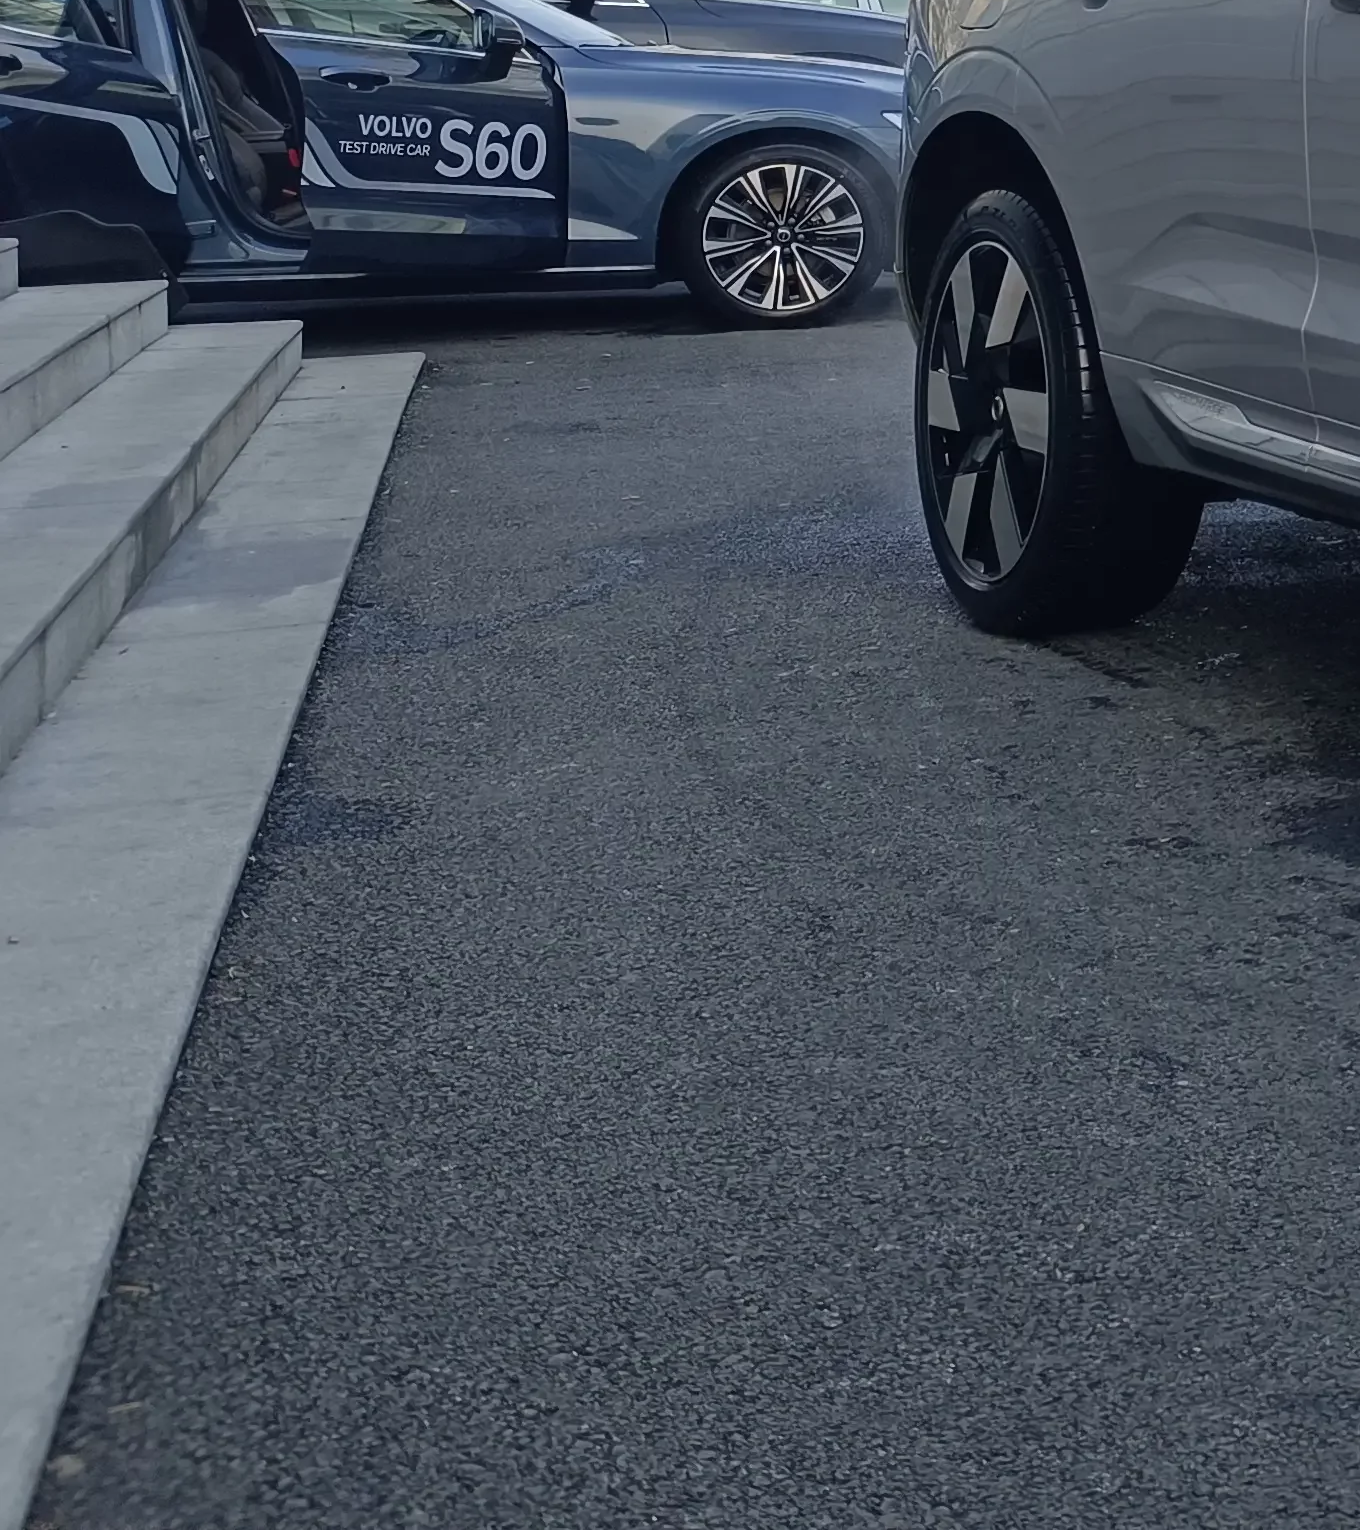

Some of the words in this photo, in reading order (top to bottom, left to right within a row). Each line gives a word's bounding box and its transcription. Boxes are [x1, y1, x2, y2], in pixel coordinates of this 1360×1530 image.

[358, 113, 433, 139] VOLVO
[338, 140, 370, 154] TEST
[370, 142, 405, 156] DRIVE
[406, 144, 431, 157] CAR
[434, 118, 547, 181] S60
